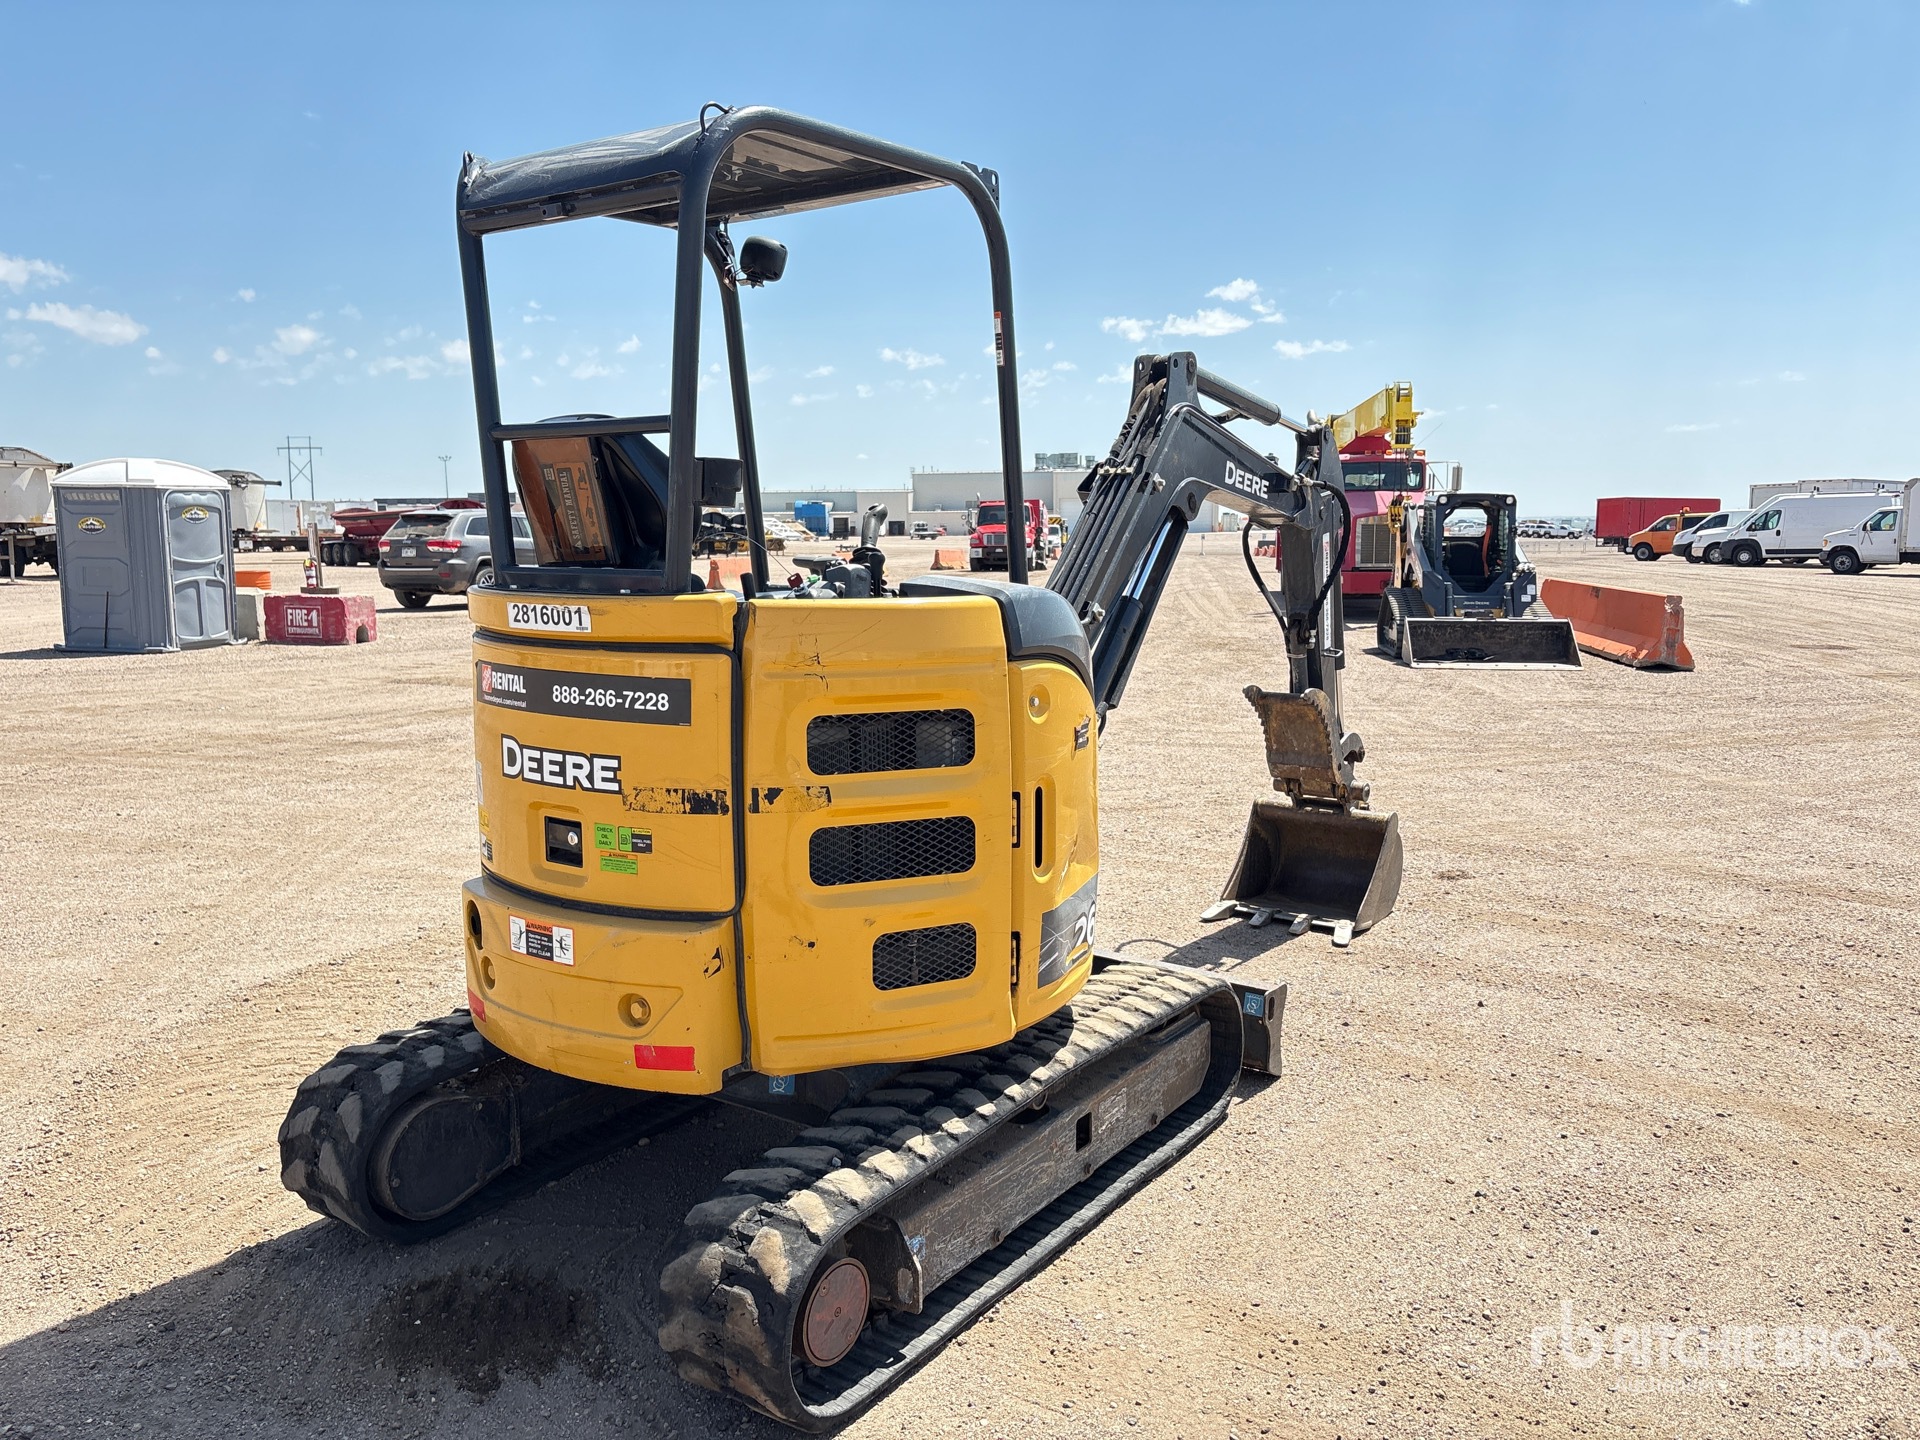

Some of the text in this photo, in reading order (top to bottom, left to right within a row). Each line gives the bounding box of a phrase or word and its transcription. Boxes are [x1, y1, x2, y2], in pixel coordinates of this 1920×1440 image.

[1224, 460, 1270, 500] DEERE
[559, 471, 580, 540] SAFETY MANUAL
[287, 608, 309, 627] FIRE
[512, 603, 583, 627] 2816001
[491, 671, 527, 694] RENTAL
[552, 684, 670, 712] 888-266-7228
[502, 736, 620, 792] DEERE
[597, 826, 614, 834] CHECK
[529, 923, 552, 933] WARNING
